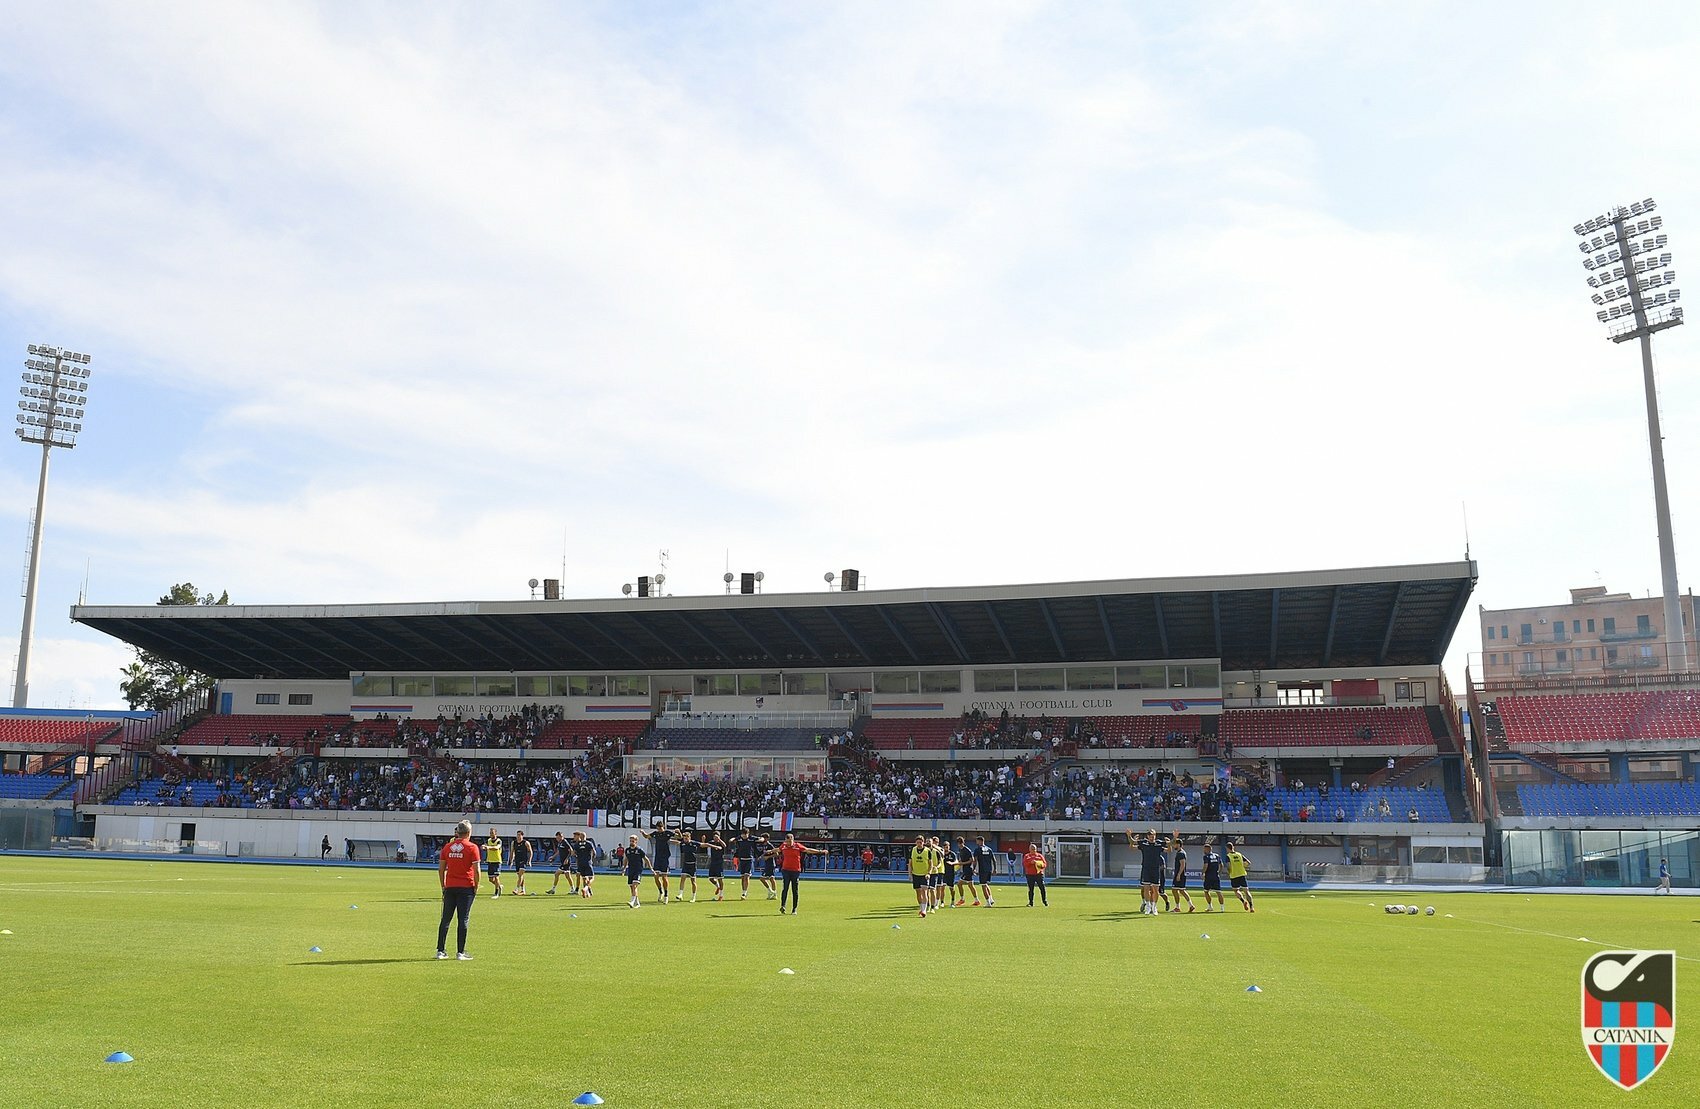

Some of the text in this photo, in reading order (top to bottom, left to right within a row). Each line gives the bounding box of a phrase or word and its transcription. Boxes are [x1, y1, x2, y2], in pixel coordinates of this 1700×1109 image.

[437, 704, 475, 713] CATANIA
[971, 698, 1113, 710] CATANIA FOOTBALL CLUB
